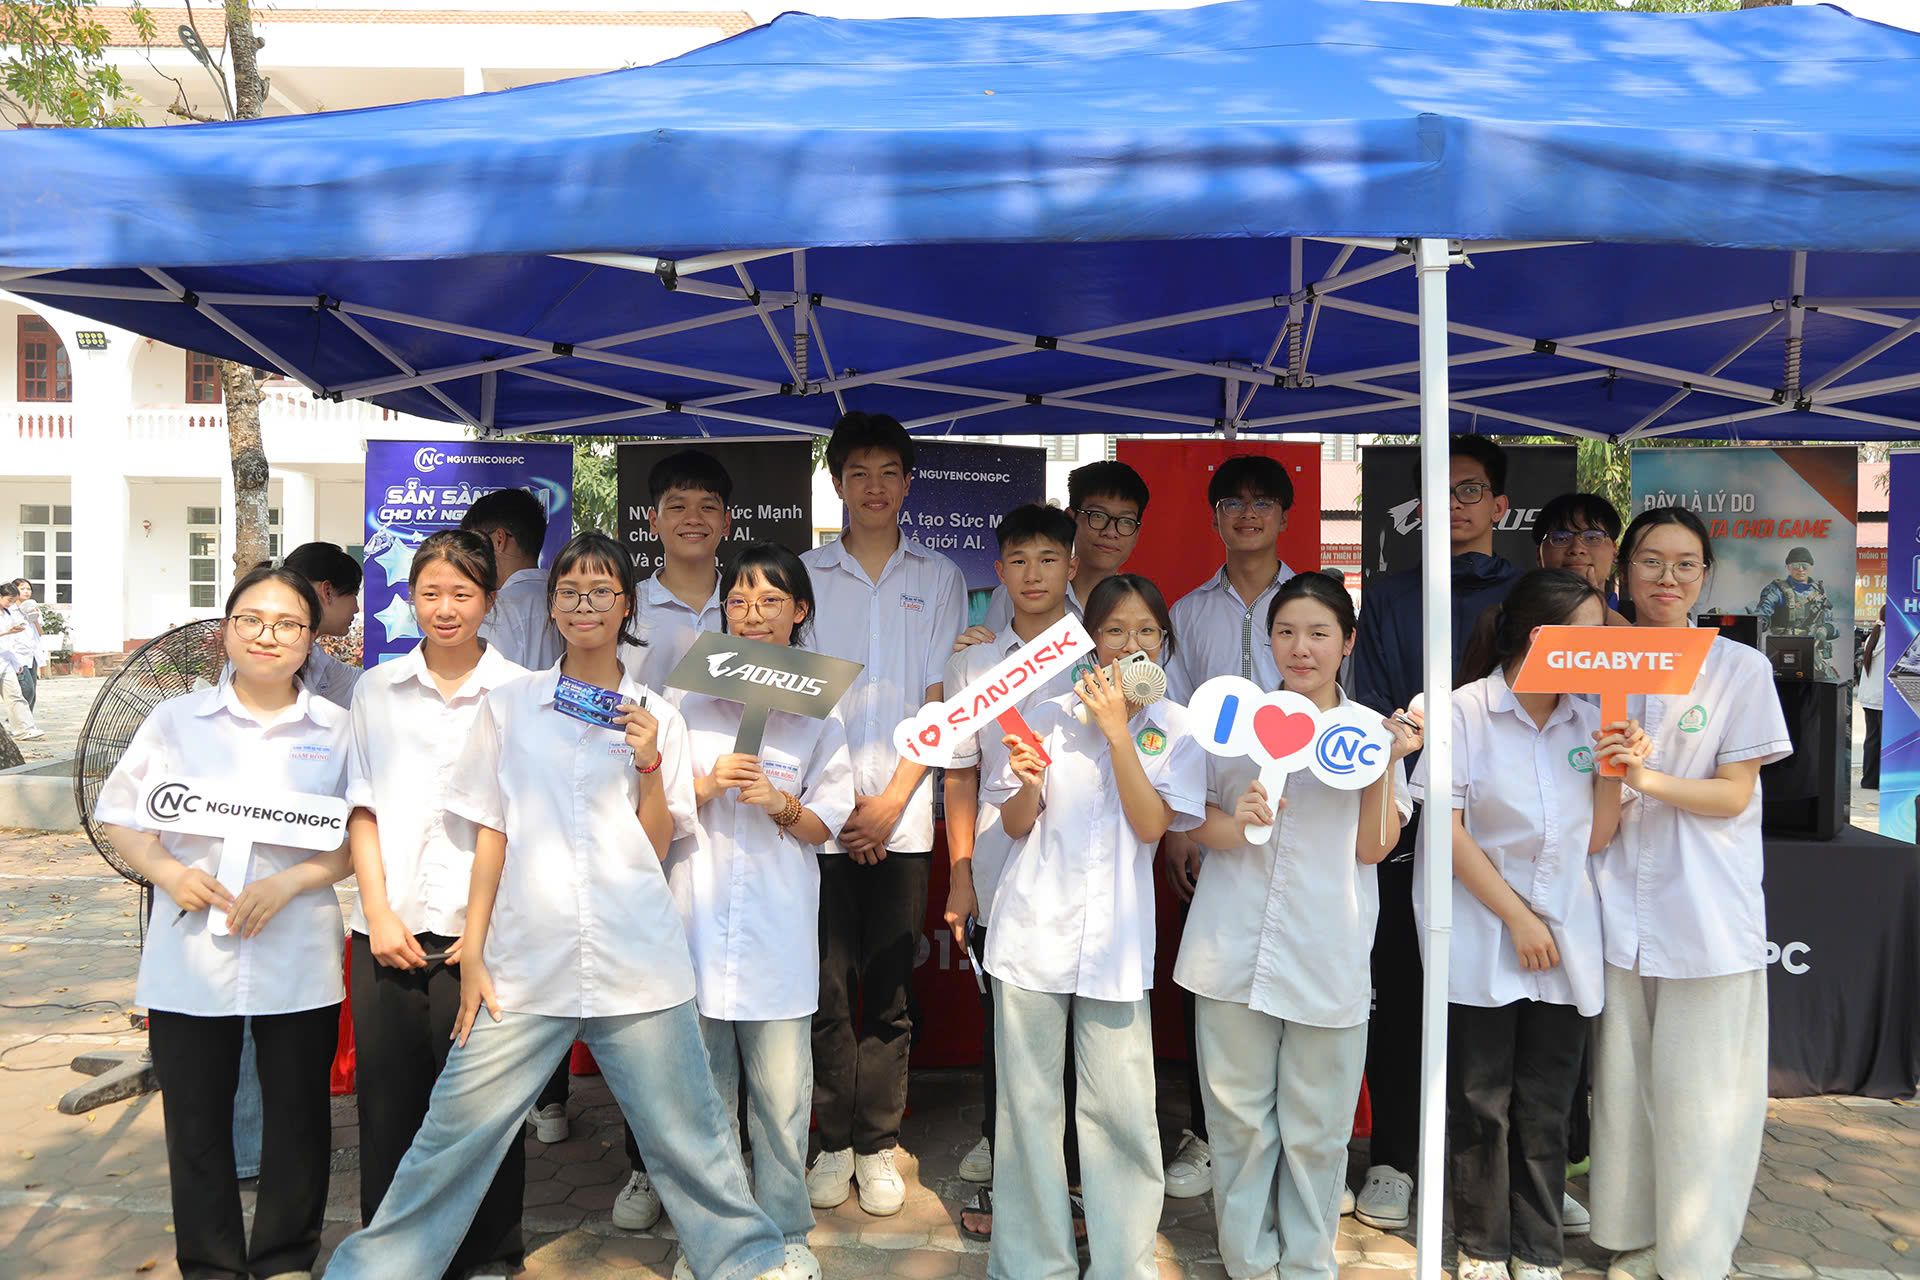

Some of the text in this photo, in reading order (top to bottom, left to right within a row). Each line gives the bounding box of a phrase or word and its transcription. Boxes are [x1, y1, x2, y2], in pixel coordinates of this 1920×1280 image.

[446, 455, 525, 465] NGUYENCONGPC
[919, 469, 1010, 483] NGUYENCONGPC
[441, 485, 498, 505] SÀN
[1644, 489, 1677, 512] ĐÂY
[1707, 489, 1726, 513] LÝ
[1731, 493, 1755, 513] DO
[380, 509, 412, 521] CHO
[728, 504, 752, 519] ức
[758, 504, 802, 522] Mạnh
[918, 512, 944, 529] tạo
[950, 512, 984, 528] Sức
[1708, 519, 1728, 538] TA
[1778, 519, 1832, 538] GAME
[925, 535, 958, 550] giới
[725, 663, 828, 696] AORUS
[947, 631, 1078, 731] SANDISK
[1213, 694, 1240, 745] I
[205, 801, 342, 830] NGUYENCONGPC
